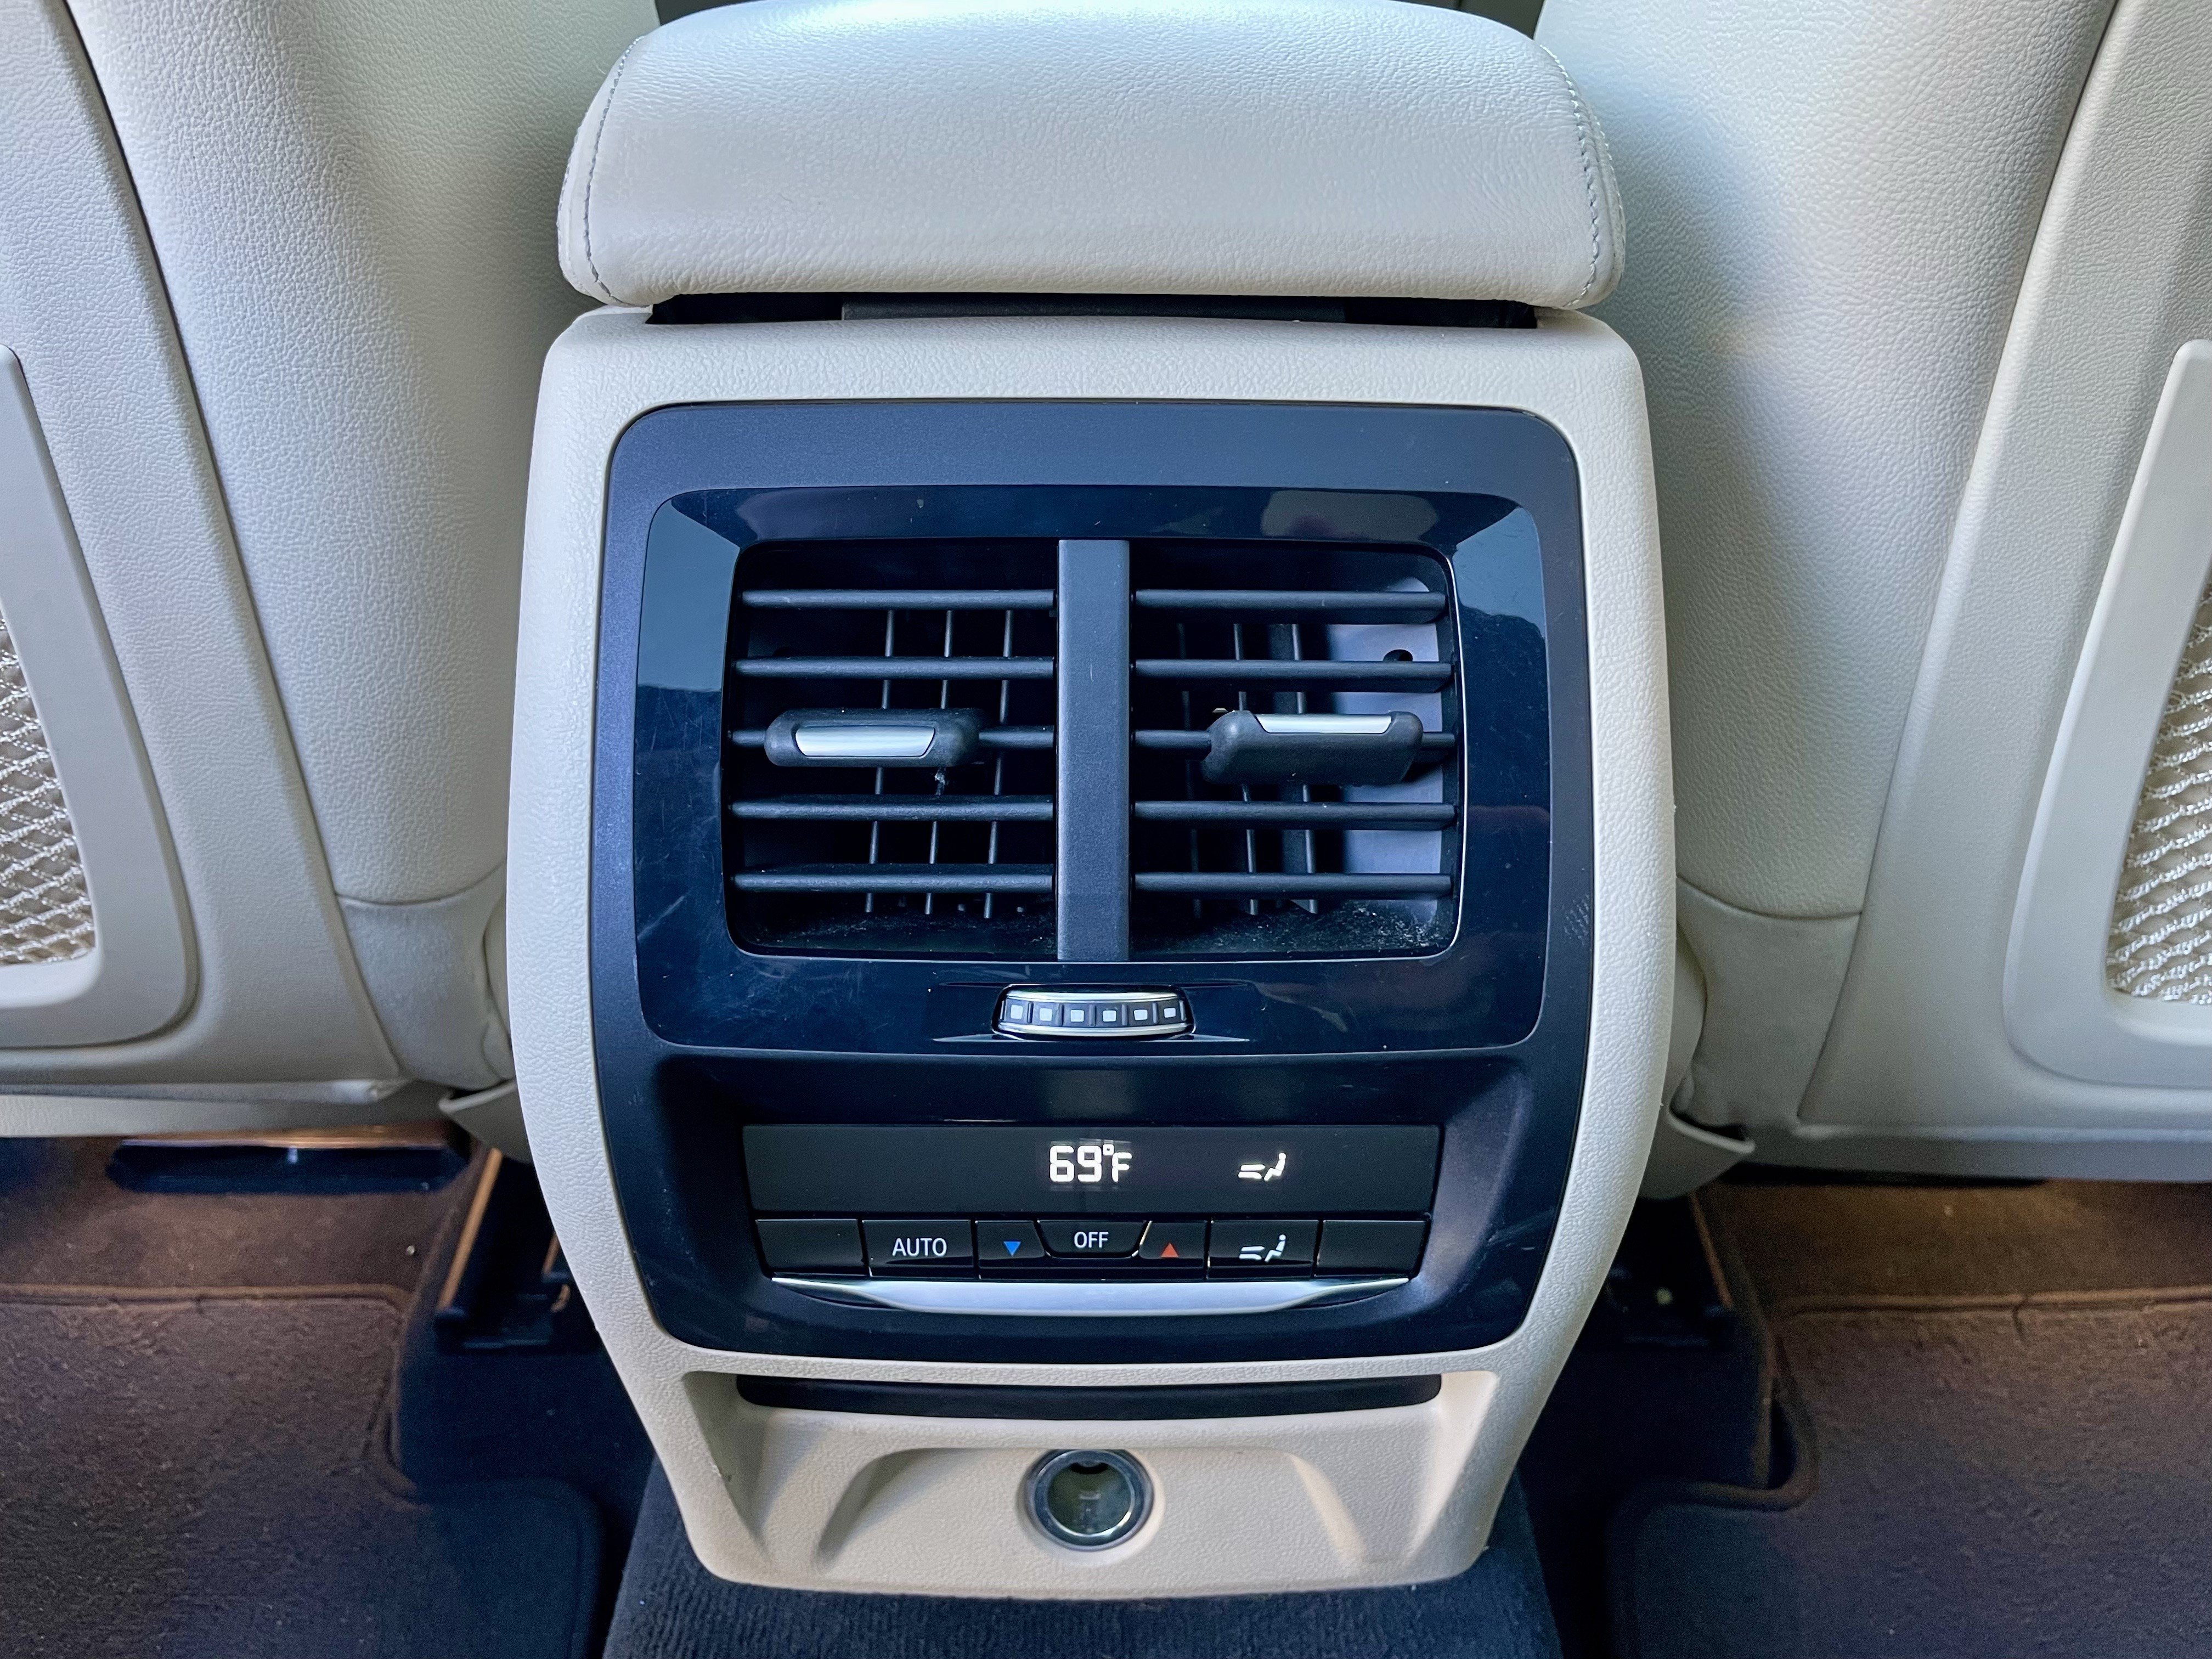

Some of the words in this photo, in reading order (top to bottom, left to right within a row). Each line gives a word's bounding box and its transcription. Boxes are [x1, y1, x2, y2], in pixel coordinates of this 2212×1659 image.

[1049, 1143, 1132, 1183] 69°F
[891, 1237, 948, 1258] AUTO
[1073, 1231, 1110, 1250] OFF
